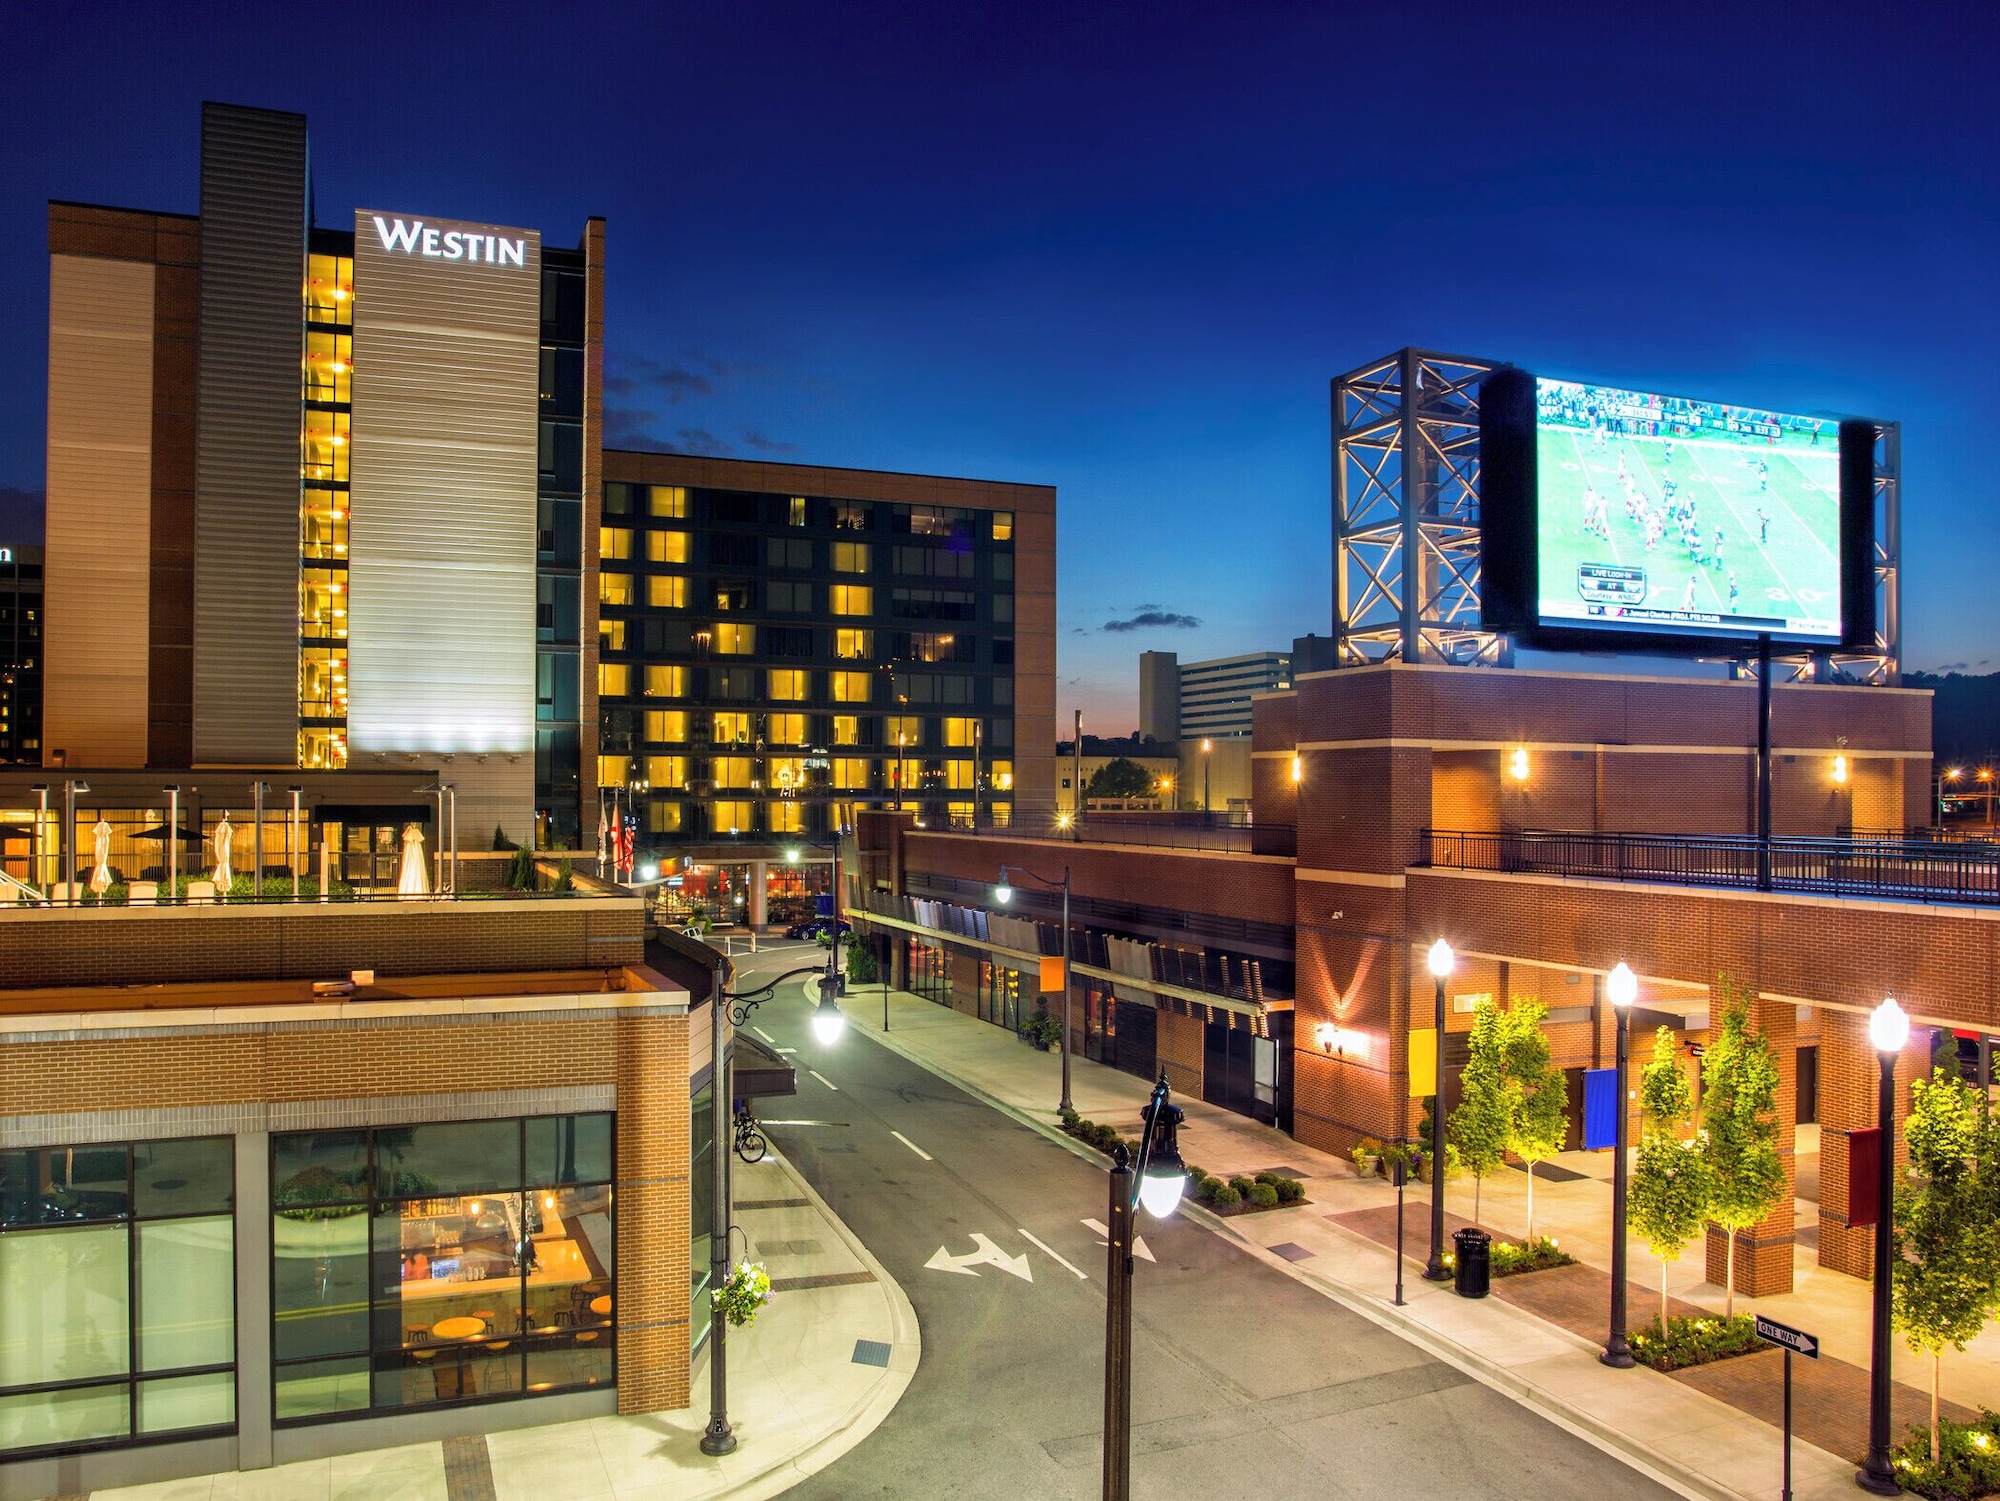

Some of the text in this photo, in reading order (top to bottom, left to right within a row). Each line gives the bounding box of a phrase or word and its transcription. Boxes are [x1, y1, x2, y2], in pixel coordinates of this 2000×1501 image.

[373, 217, 525, 267] WESTIN
[1591, 569, 1607, 577] LIVE
[1607, 582, 1617, 590] AT
[1761, 1323, 1798, 1345] ONE WAY
